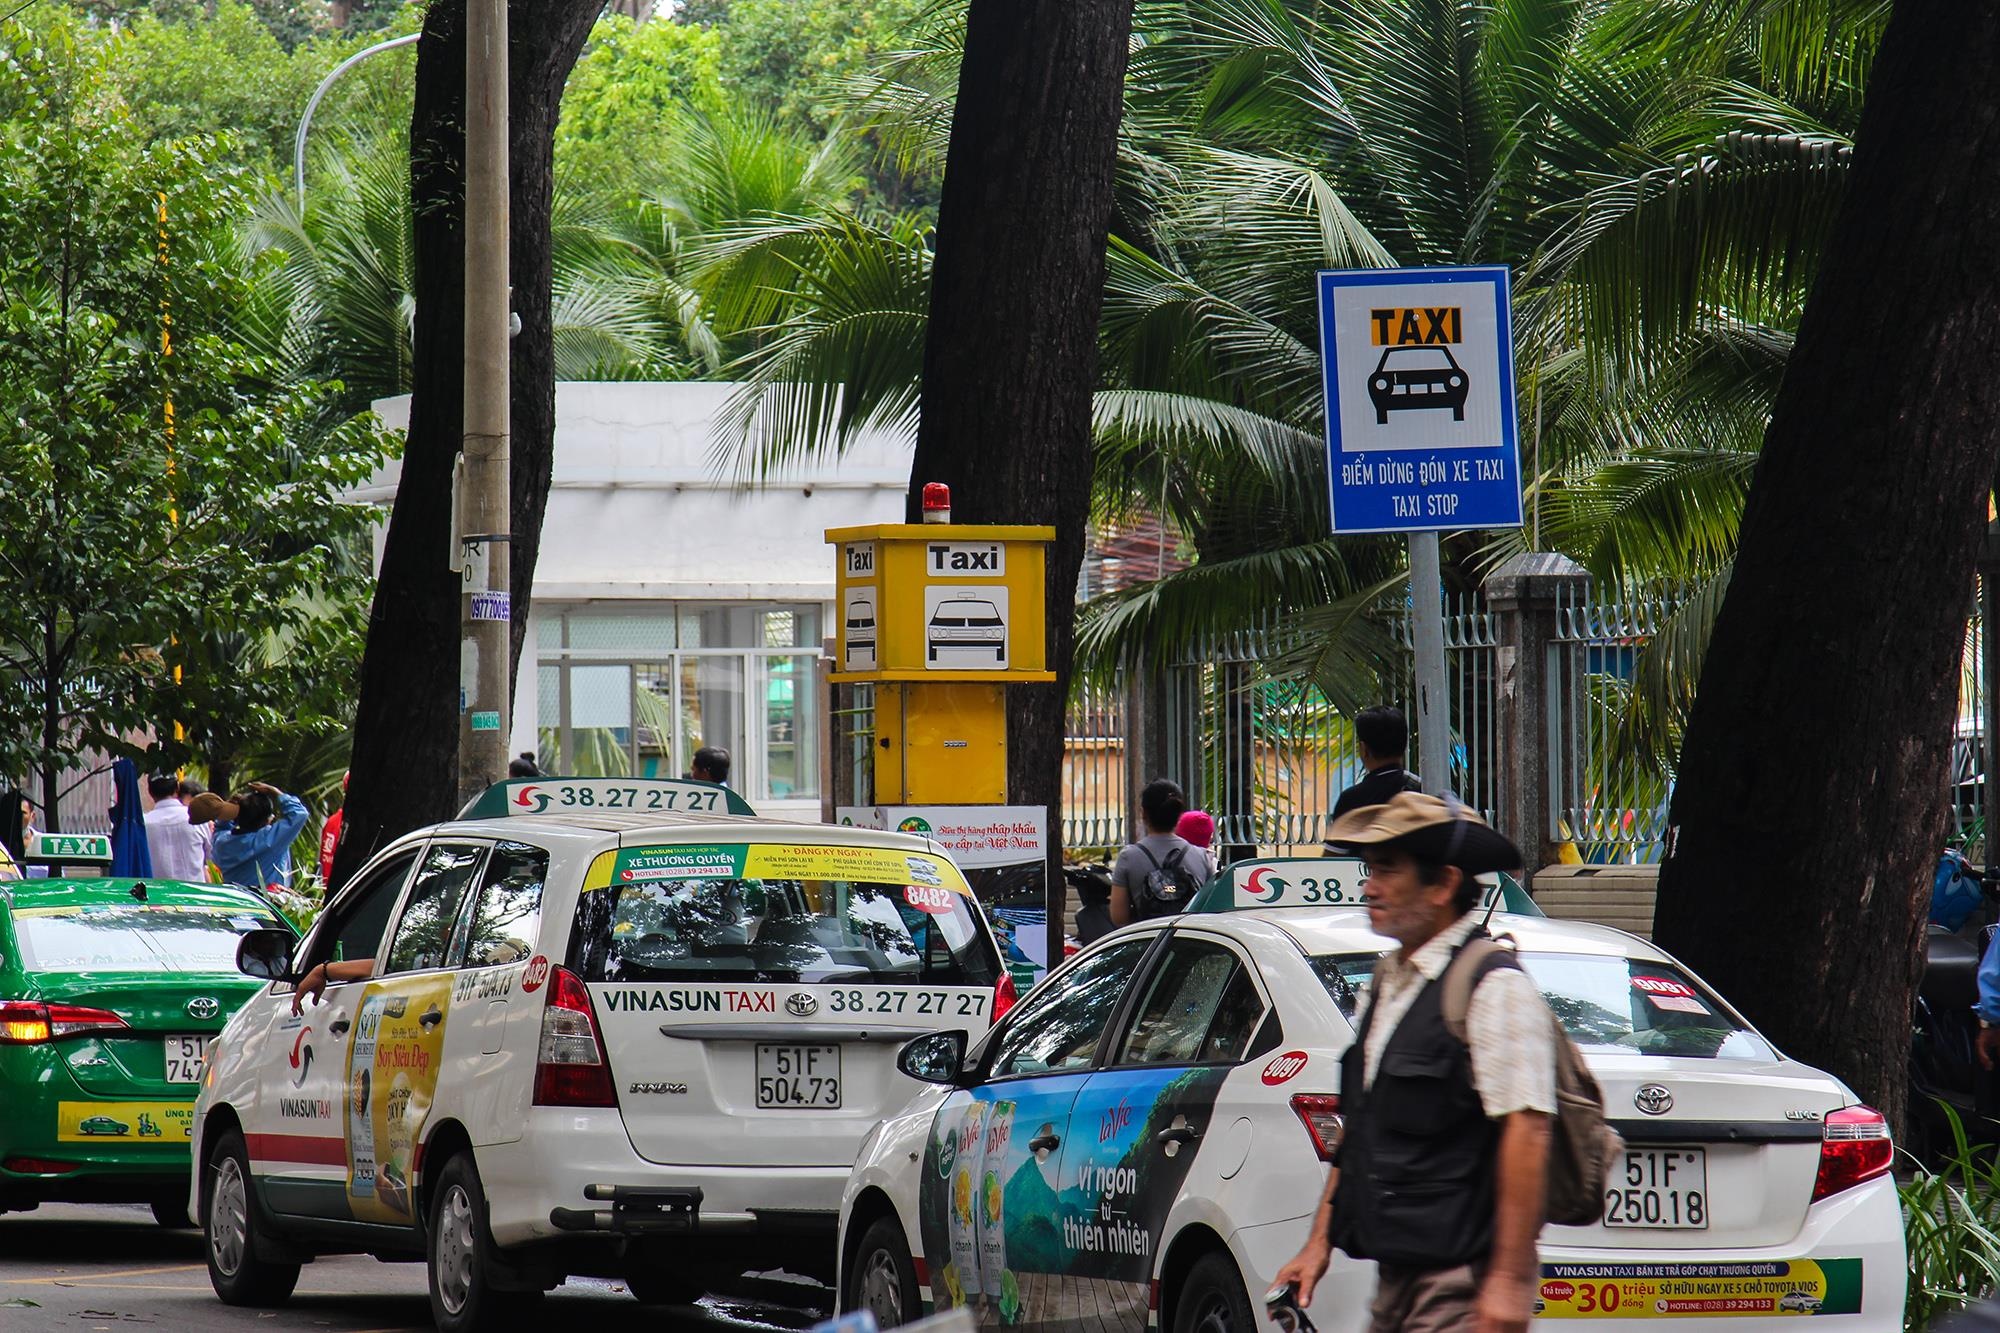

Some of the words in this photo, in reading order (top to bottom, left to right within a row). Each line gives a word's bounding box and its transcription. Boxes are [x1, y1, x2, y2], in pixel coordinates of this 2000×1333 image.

[1371, 308, 1462, 345] TAXI
[1342, 453, 1374, 486] ĐIỂM
[1379, 457, 1414, 484] DỪNG
[1419, 456, 1447, 484] ĐÓN
[1453, 460, 1470, 482] XE
[1475, 459, 1504, 481] TAXI
[1392, 495, 1421, 517] TAXI
[1428, 494, 1459, 516] STOP
[846, 546, 873, 572] Taxi
[928, 546, 998, 570] Taxi
[560, 786, 638, 808] 38.27
[646, 789, 678, 809] 27
[687, 791, 719, 811] 27
[986, 822, 1011, 839] nhập
[1012, 820, 1036, 835] khẩu
[837, 848, 862, 857] NGAY
[955, 836, 973, 853] cấp
[985, 836, 1009, 850] Việt
[1010, 837, 1039, 850] Nam
[628, 858, 643, 868] XE
[644, 856, 695, 866] THƯƠNG
[906, 885, 952, 908] 8482
[522, 962, 547, 986] 8482
[1633, 978, 1692, 996] 9091
[829, 990, 908, 1013] 38.27
[917, 992, 948, 1014] 27
[956, 994, 986, 1016] 27
[776, 1048, 822, 1076] 51F
[1263, 1056, 1307, 1078] 9091
[759, 1077, 839, 1106] 504.73
[1079, 1157, 1093, 1199] vị
[1096, 1165, 1137, 1200] ngon
[1626, 1152, 1680, 1187] 51F
[1101, 1202, 1112, 1221] từ
[1605, 1188, 1704, 1225] 250.18
[1063, 1216, 1104, 1253] thiên
[1108, 1219, 1149, 1257] nhiên
[1554, 1266, 1613, 1276] VINASUN
[1613, 1266, 1635, 1276] TAXI
[1636, 1264, 1654, 1276] BÁN
[1654, 1265, 1664, 1276] XE
[1665, 1263, 1680, 1276] TRẢ
[1682, 1264, 1696, 1276] GÓP
[1699, 1265, 1719, 1278] CHẠY
[1542, 1285, 1554, 1295] Trả
[1577, 1283, 1620, 1312] 30
[1622, 1282, 1655, 1299] triệu
[1659, 1280, 1672, 1295] SỞ
[1697, 1282, 1721, 1294] NGAY
[1723, 1282, 1734, 1294] XE
[1736, 1283, 1741, 1293] 5
[1744, 1278, 1762, 1293] CHỖ
[1763, 1281, 1796, 1293] TOYOTA
[1797, 1281, 1818, 1293] VIOS
[1669, 1302, 1702, 1310] HOTLINE:
[1703, 1301, 1724, 1310] (028)
[1725, 1300, 1737, 1309] 39
[1737, 1300, 1755, 1309] 294
[1756, 1299, 1771, 1309] 133
